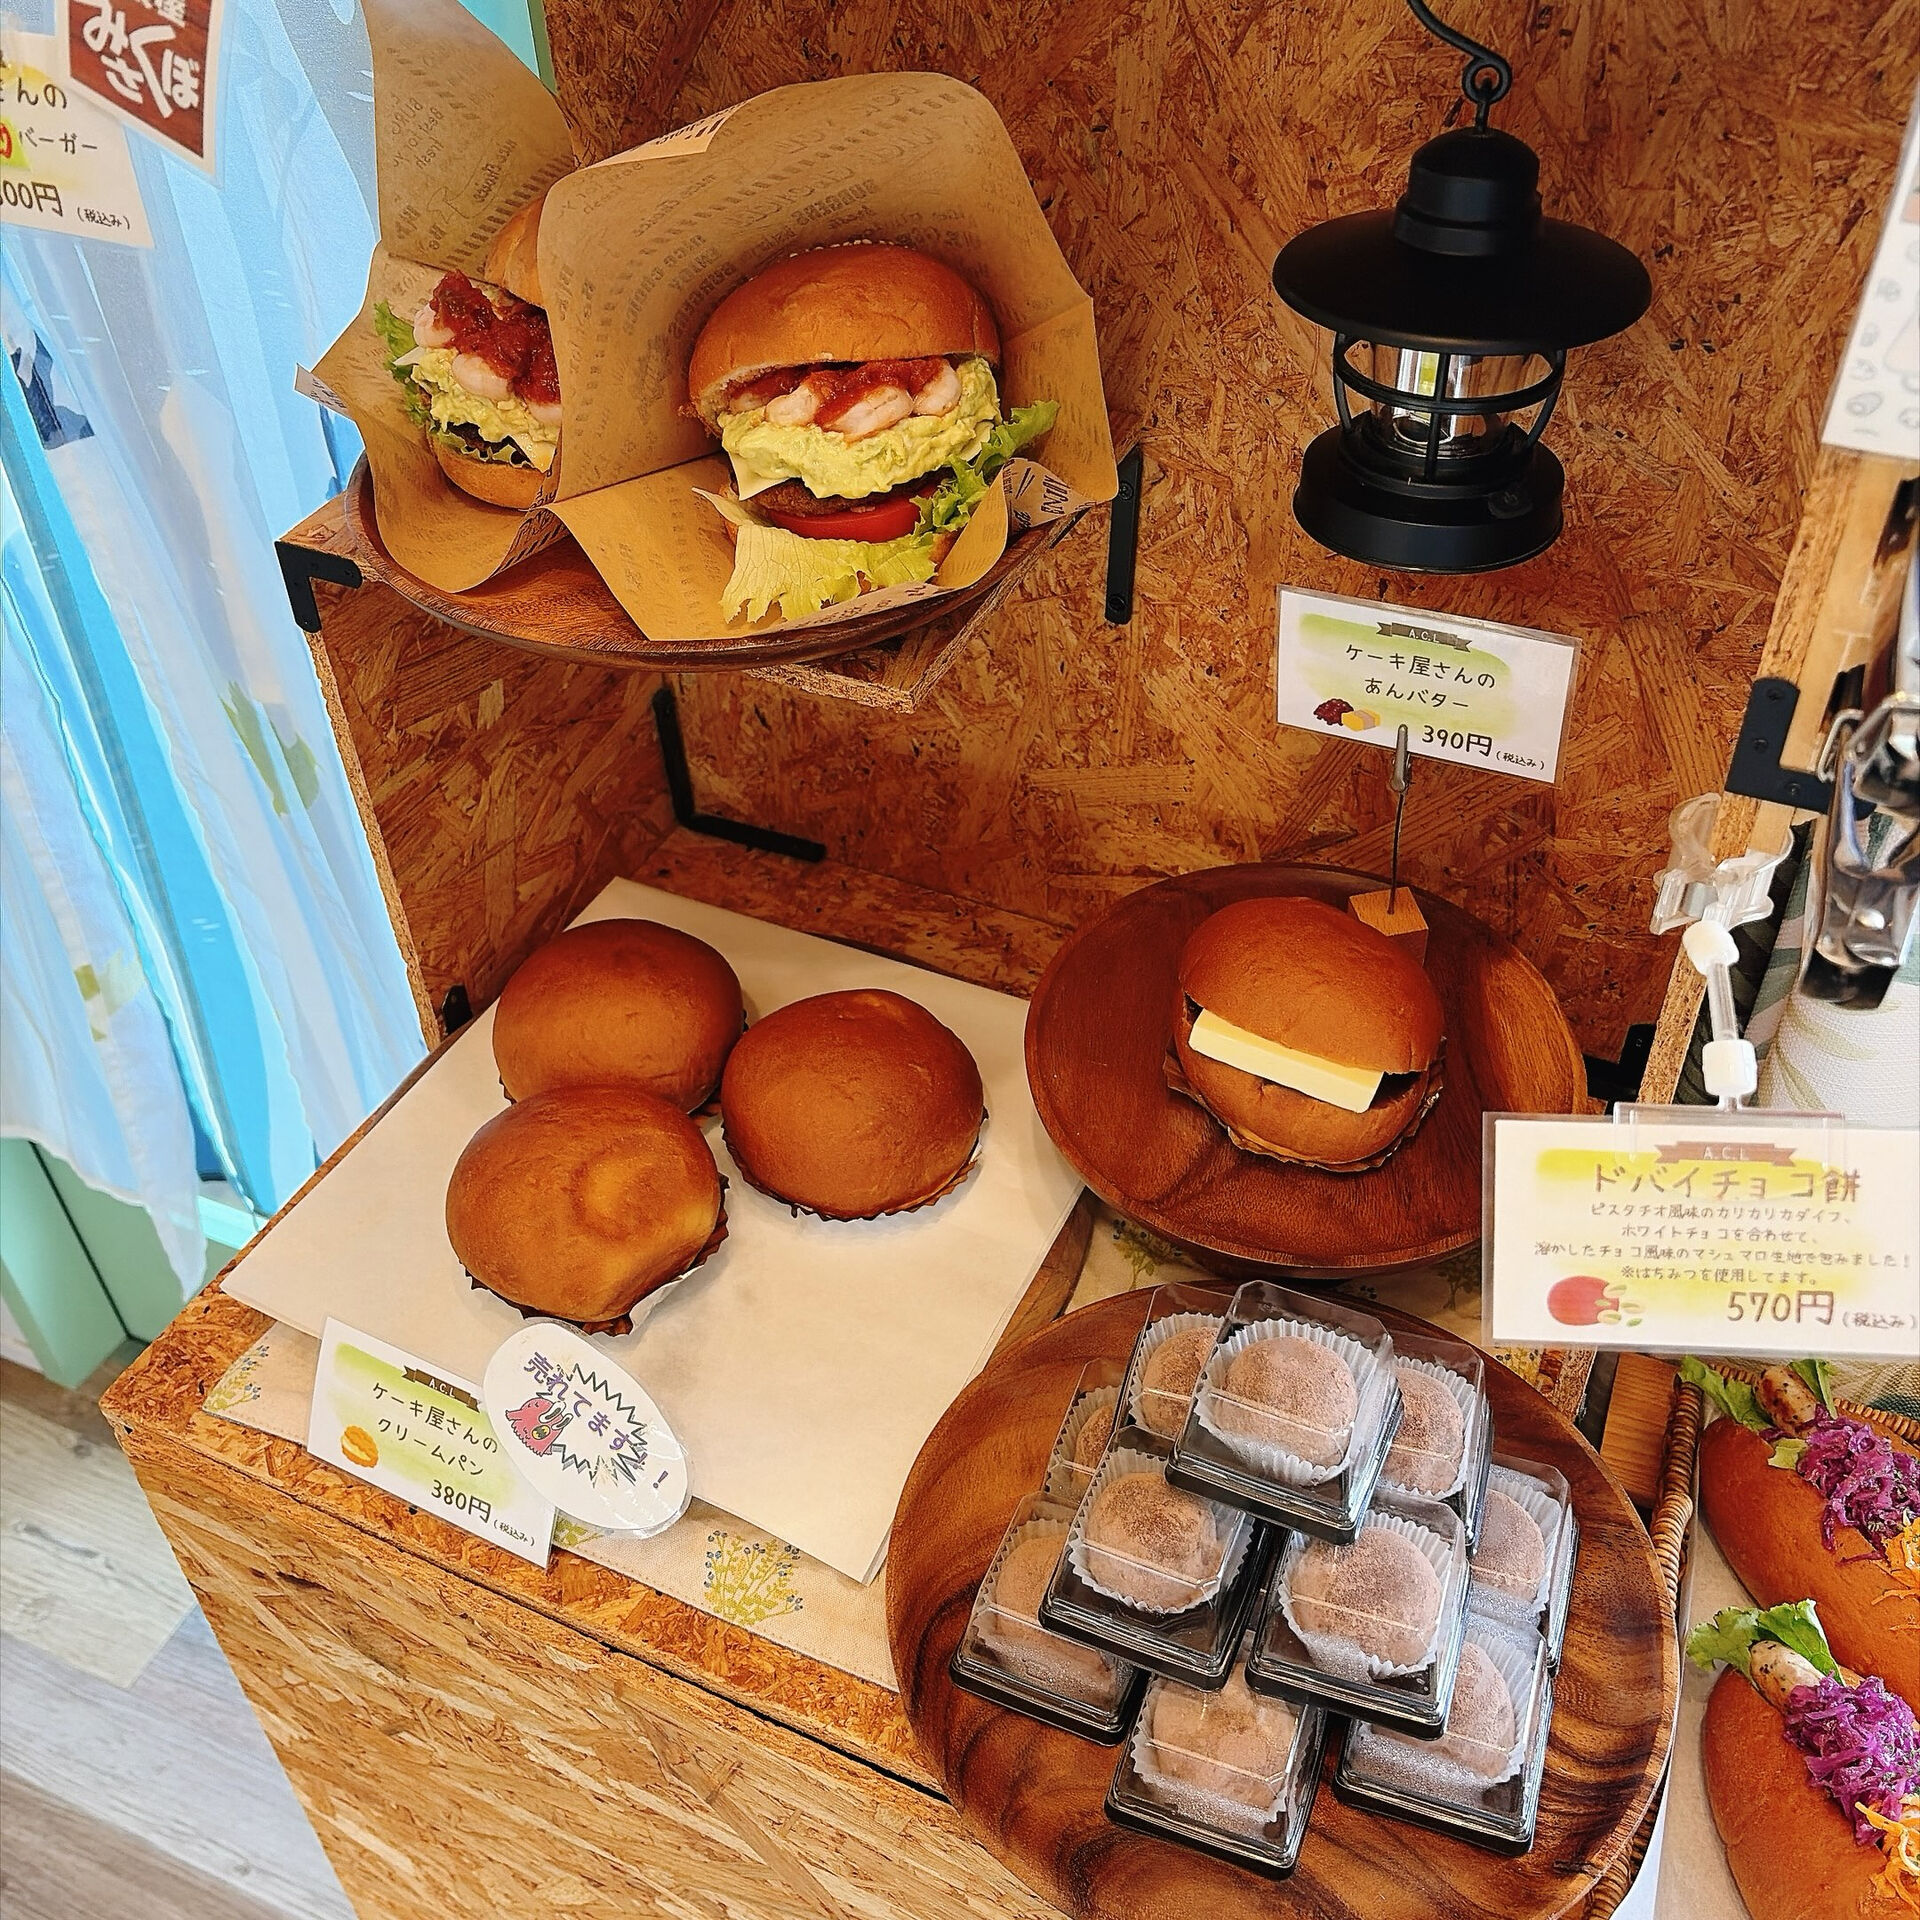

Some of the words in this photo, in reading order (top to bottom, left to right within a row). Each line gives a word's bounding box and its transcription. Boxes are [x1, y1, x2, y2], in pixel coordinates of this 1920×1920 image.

[0, 76, 68, 110] んの
[0, 180, 64, 217] 00円
[1408, 628, 1440, 644] A.C.L
[1346, 644, 1496, 689] ケーキ屋さんの
[1364, 677, 1469, 709] あんバター
[1421, 725, 1493, 756] 390円
[1595, 1163, 1861, 1202] ドバイチョコ餅
[1727, 1290, 1835, 1326] 570円
[429, 1378, 456, 1398] A.C.L
[373, 1382, 498, 1454] ケーキ屋さんの
[378, 1418, 484, 1476] クリームパン
[431, 1479, 492, 1523] 380円
